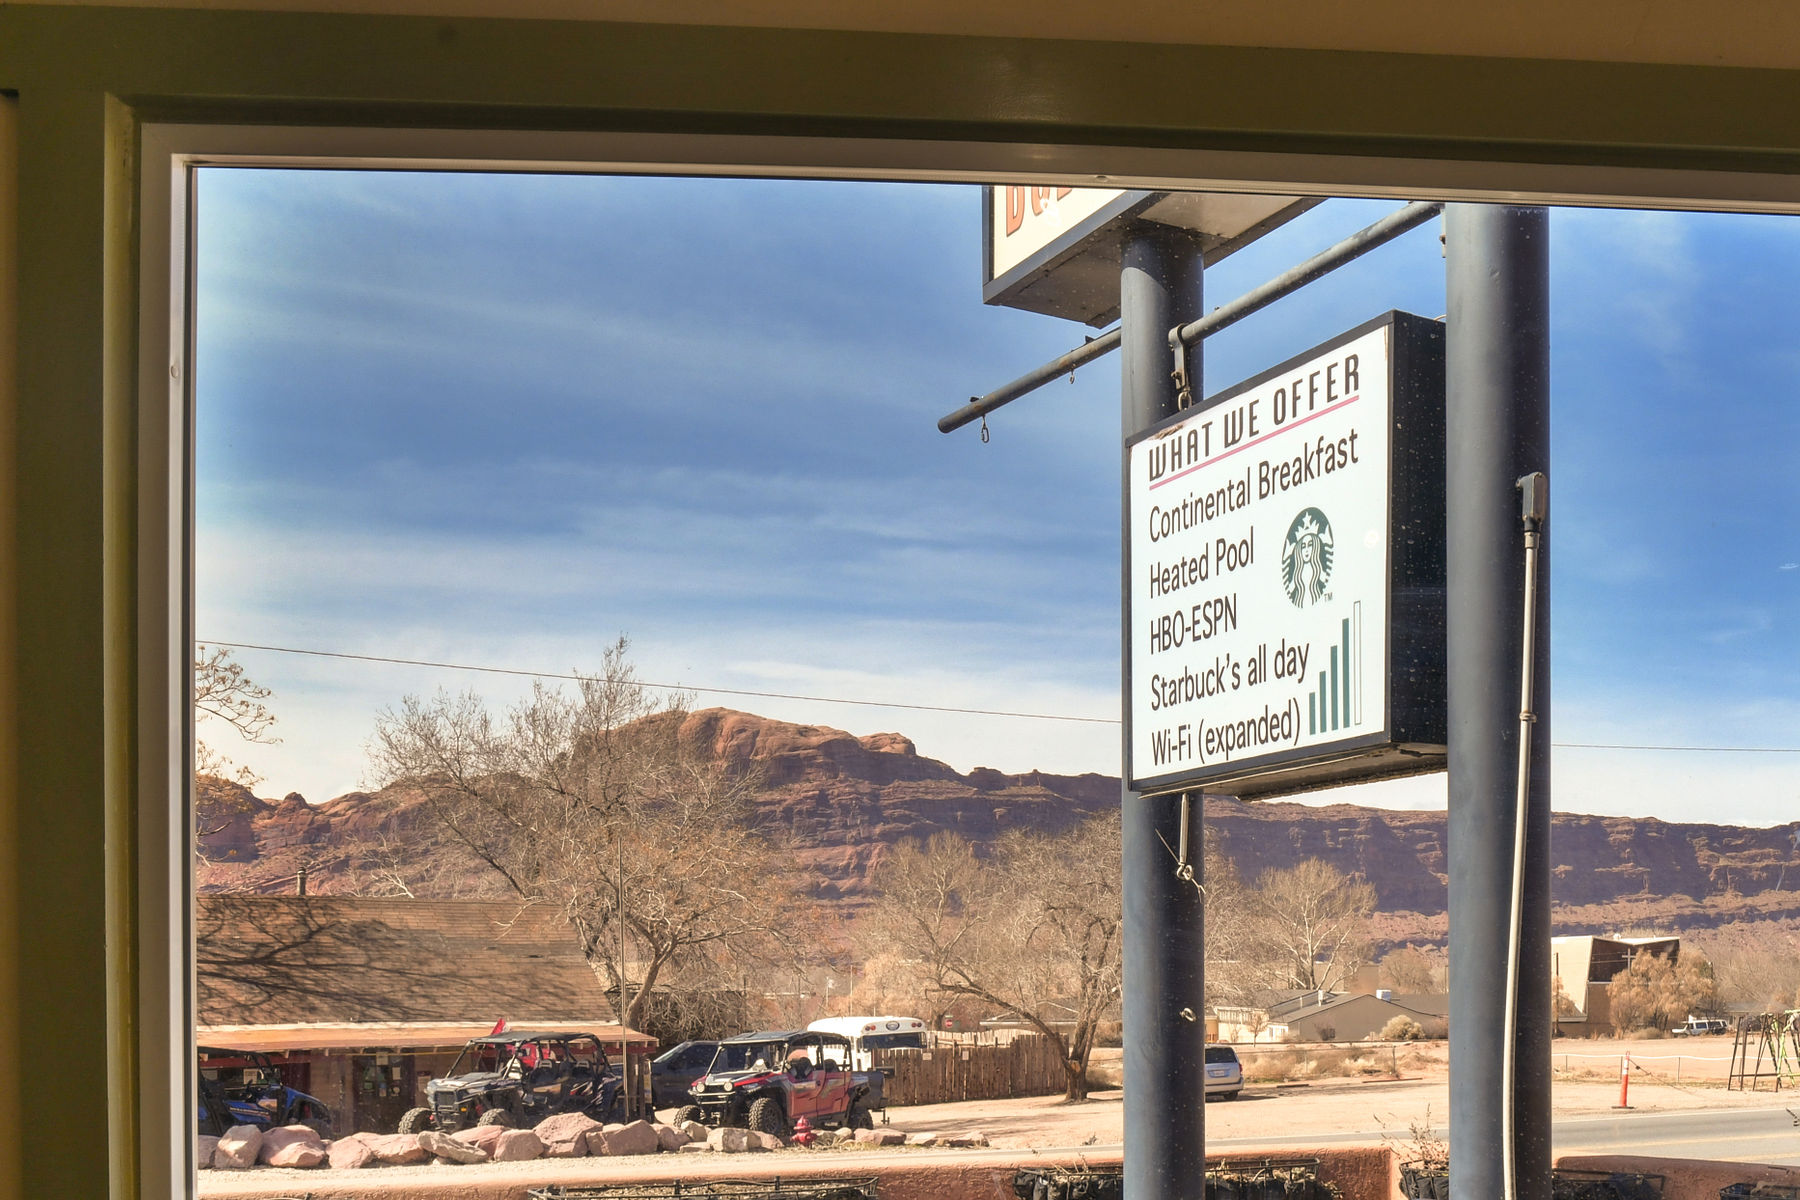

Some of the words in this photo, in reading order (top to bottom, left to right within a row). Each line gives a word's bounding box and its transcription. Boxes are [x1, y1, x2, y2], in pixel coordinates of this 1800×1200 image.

[1149, 421, 1213, 482] WHAT
[1223, 399, 1260, 449] WE
[1273, 353, 1360, 426] OFFER
[1149, 466, 1251, 543] Continental
[1258, 428, 1359, 500] Breakfast
[1150, 542, 1209, 599] Heated
[1216, 525, 1254, 576] Pool
[1323, 592, 1333, 603] TM
[1150, 592, 1237, 655] HBO-ESPN
[1151, 652, 1241, 711] Starbuck's
[1247, 643, 1267, 686] all
[1273, 638, 1310, 684] day
[1151, 723, 1192, 766] Wi-Fi
[1198, 697, 1301, 765] (expanded)
